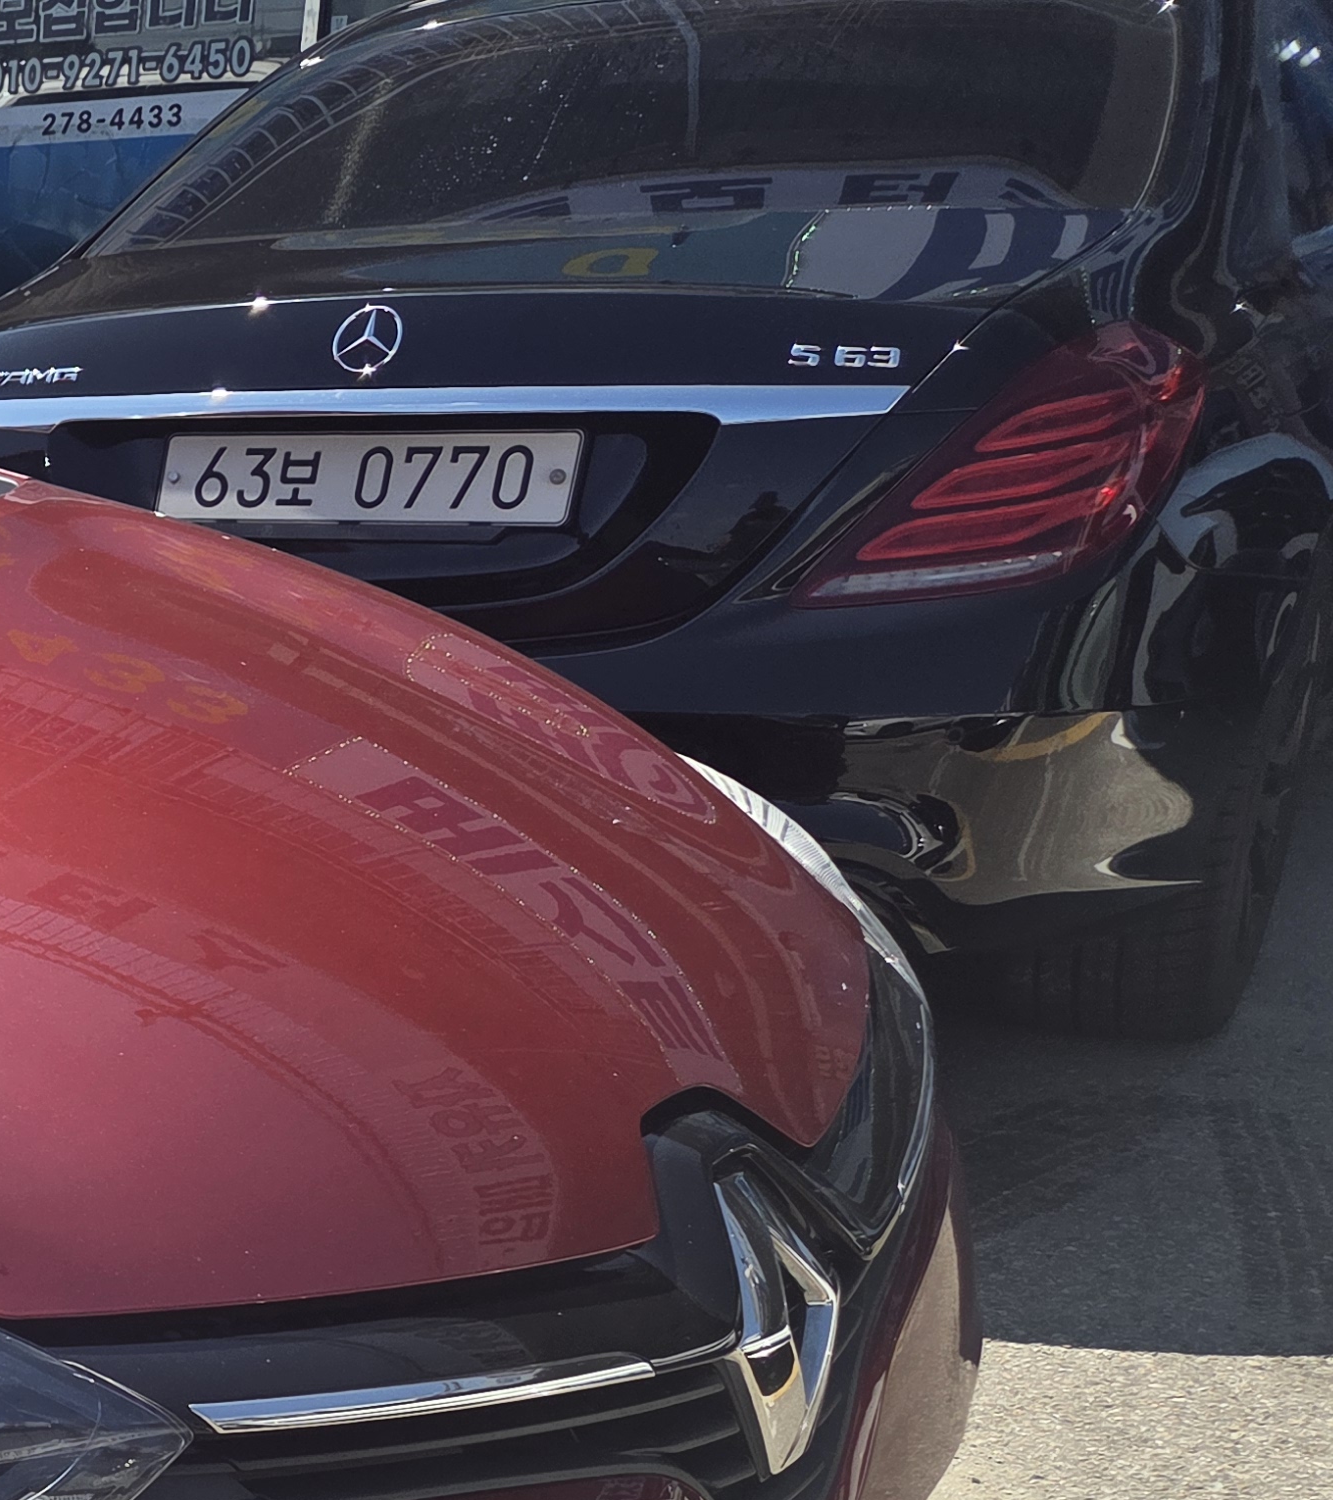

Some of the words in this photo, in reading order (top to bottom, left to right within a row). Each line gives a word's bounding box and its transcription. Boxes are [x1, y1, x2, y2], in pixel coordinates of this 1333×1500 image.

[42, 103, 182, 136] 278-4433
[788, 343, 822, 367] S
[834, 345, 901, 368] 63
[0, 366, 83, 387] AMG
[194, 446, 322, 508] 63보
[354, 444, 534, 510] 0770
